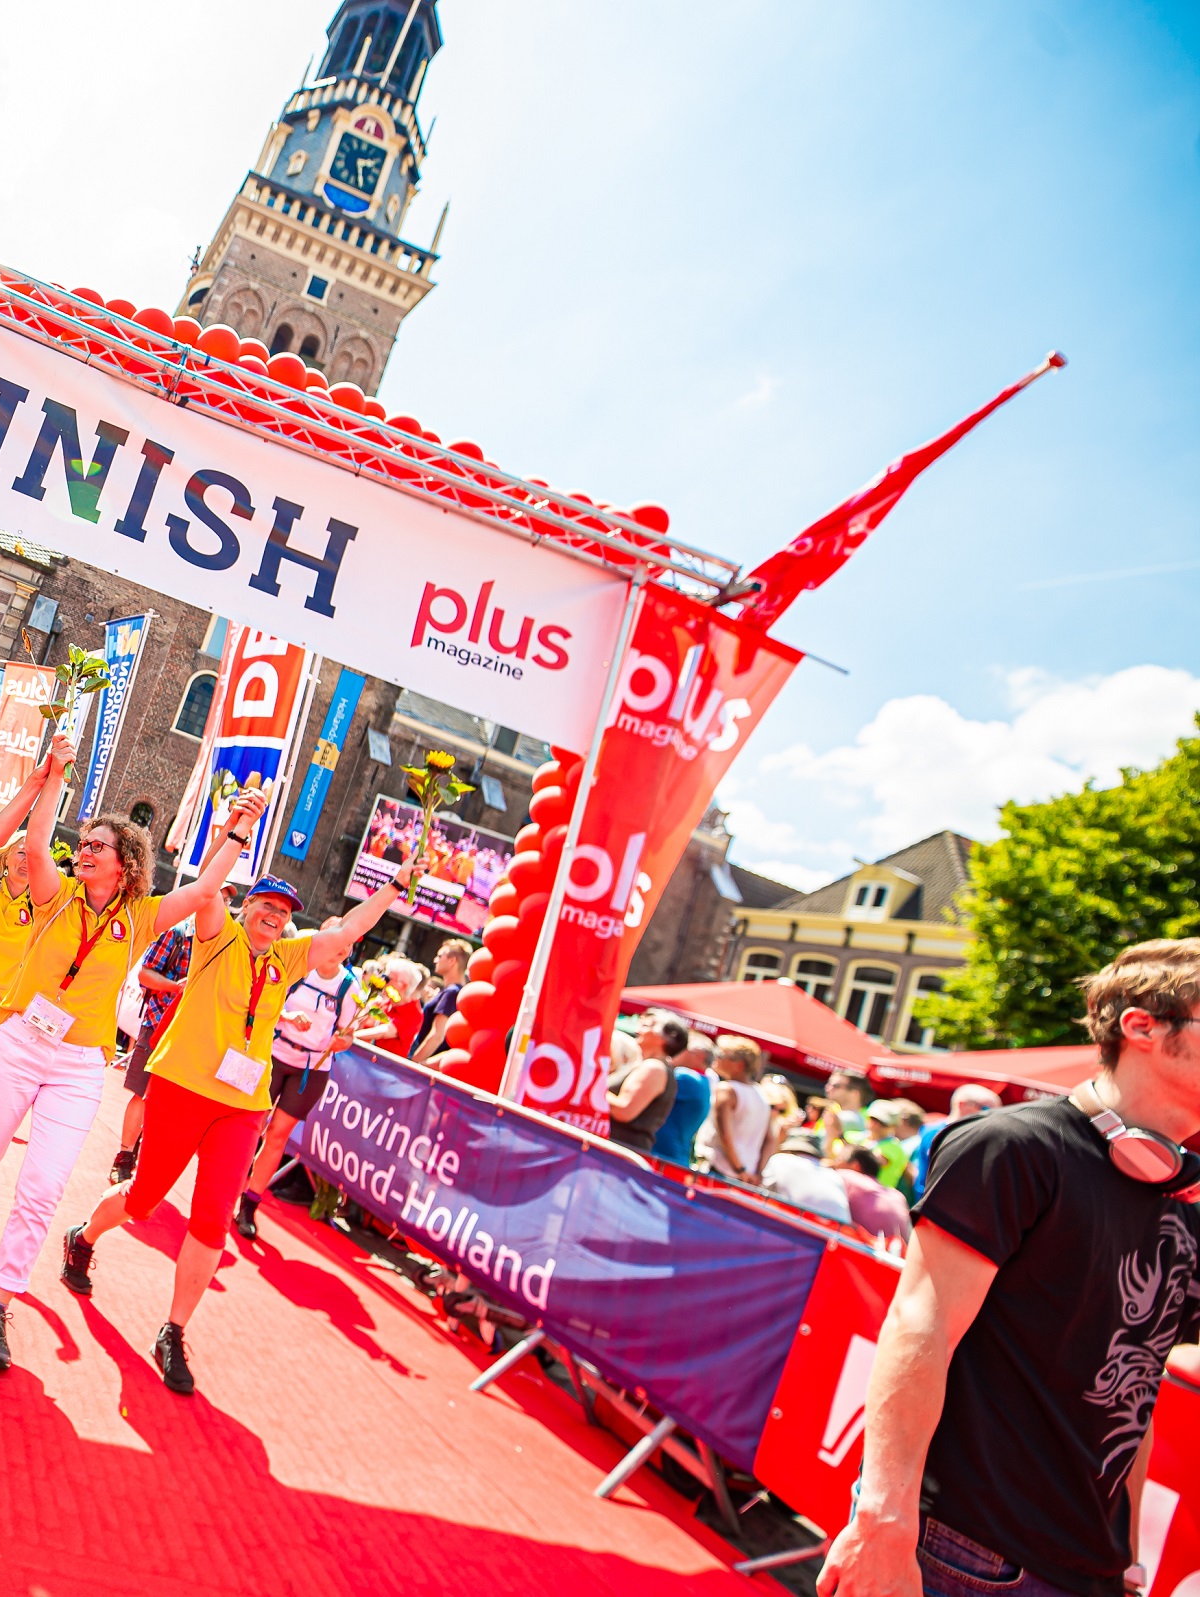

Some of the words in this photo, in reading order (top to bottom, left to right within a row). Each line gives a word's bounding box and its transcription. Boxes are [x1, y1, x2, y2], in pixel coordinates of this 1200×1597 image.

[409, 579, 572, 672] plus
[425, 634, 524, 682] magazine
[327, 697, 348, 743] Hollands
[603, 643, 752, 752] plus
[304, 766, 324, 811] museum
[319, 741, 335, 767] Kaas
[564, 832, 652, 928] pls
[318, 1079, 461, 1186] Provincie
[310, 1121, 557, 1311] Noord-Holland
